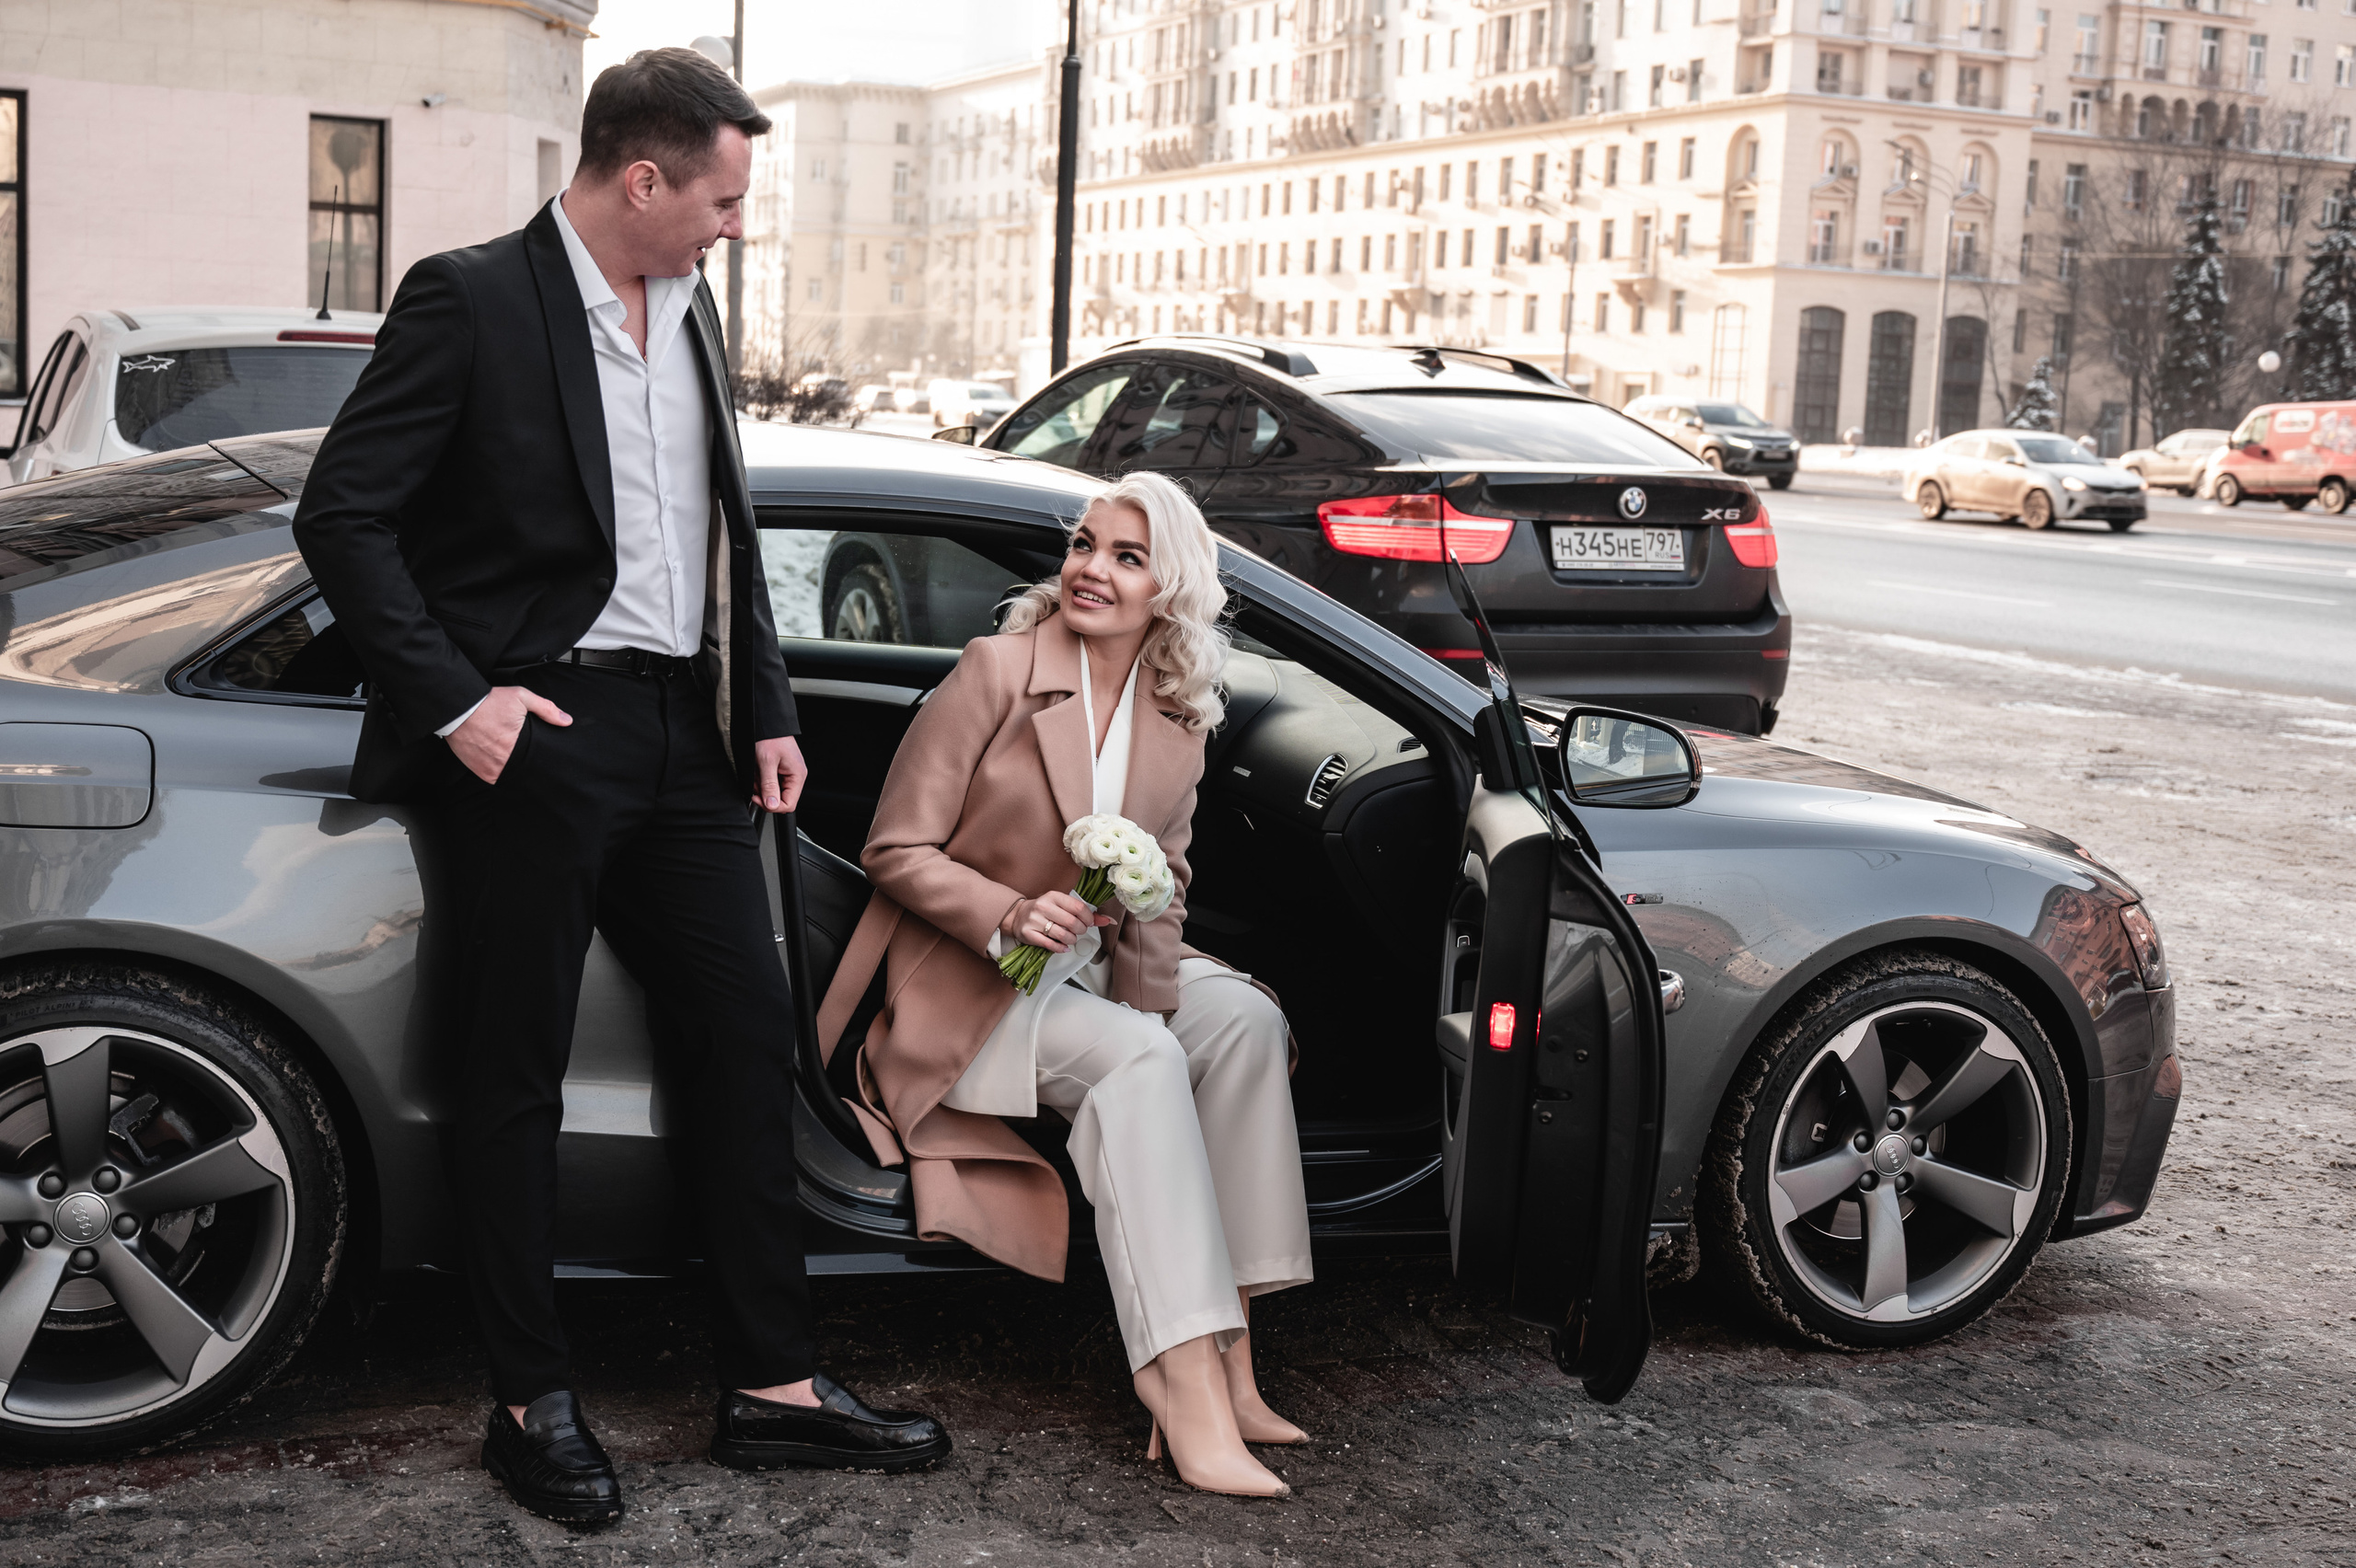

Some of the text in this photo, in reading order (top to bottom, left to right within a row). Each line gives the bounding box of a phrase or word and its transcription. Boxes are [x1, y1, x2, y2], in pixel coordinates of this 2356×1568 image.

[1701, 508, 1740, 520] X6
[1559, 532, 1675, 558] Н345НЕ 797
[15, 1007, 40, 1018] PILOT
